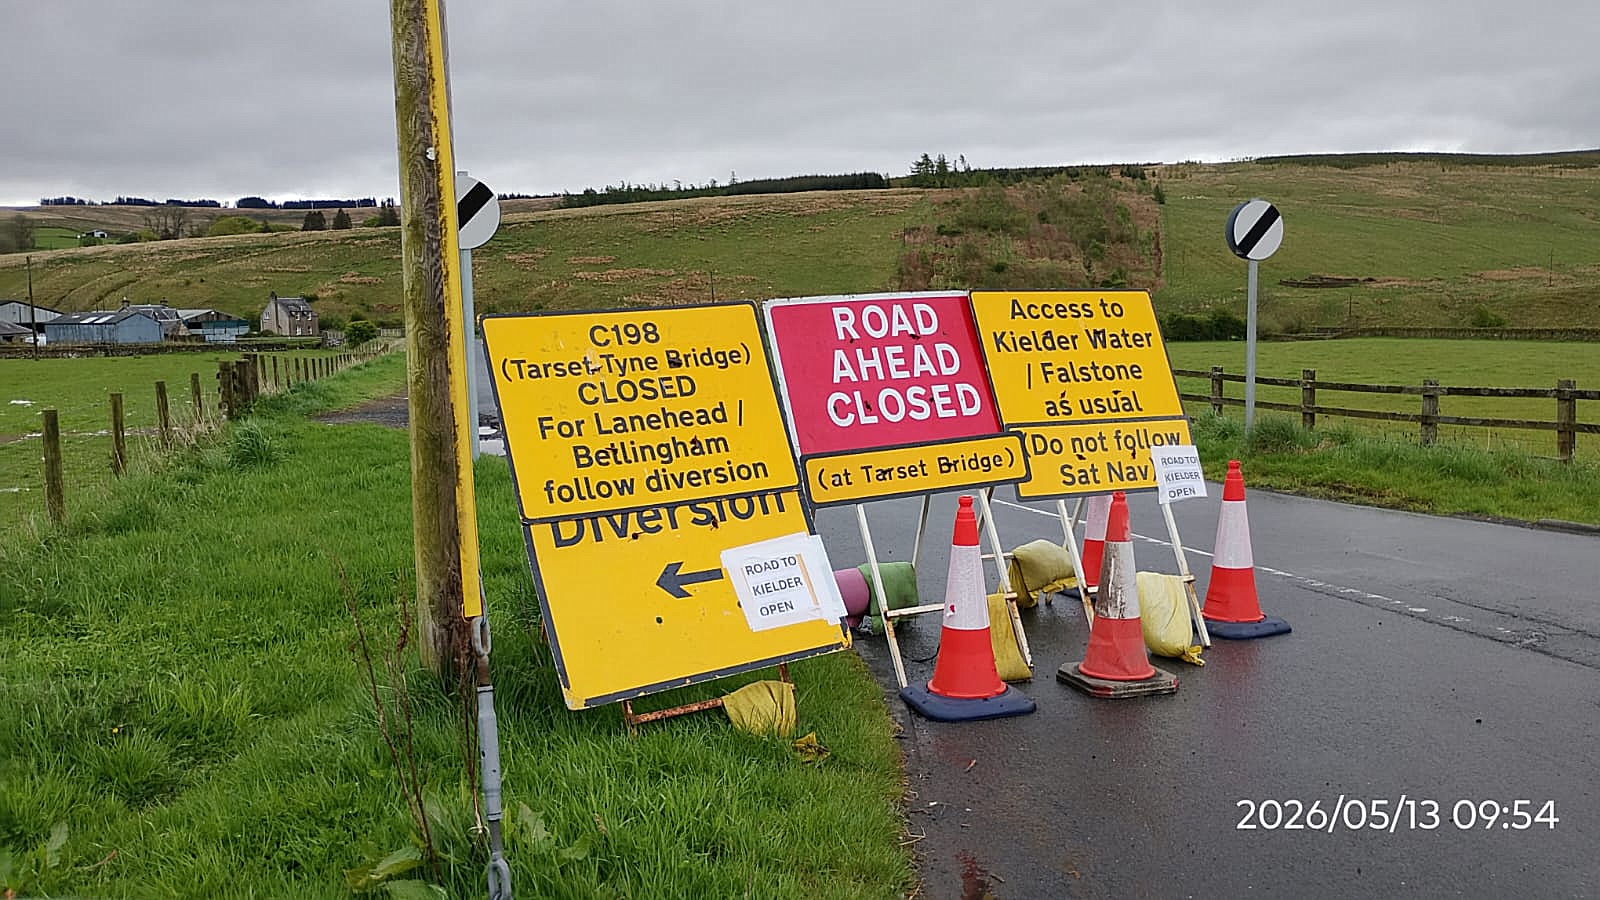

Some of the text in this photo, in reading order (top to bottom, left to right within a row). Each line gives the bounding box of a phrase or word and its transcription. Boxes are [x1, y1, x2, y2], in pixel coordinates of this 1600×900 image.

[832, 303, 939, 340] ROAD
[1010, 298, 1124, 320] Access to
[589, 322, 660, 348] C198
[993, 328, 1152, 352] Kielder Water
[501, 342, 751, 382] (Tarset Tyne Bridge)
[833, 343, 961, 384] AHEAD
[1026, 361, 1142, 390] / Falstone
[578, 375, 697, 406] CLOSED
[826, 383, 982, 427] CLOSED
[1045, 391, 1143, 417] as usual
[538, 400, 744, 441] For Lanehead /
[1071, 432, 1108, 456] not
[1114, 428, 1181, 452] follow
[818, 447, 1014, 490] (at Tarset Bridge)
[1161, 455, 1198, 466] ROAD TO
[543, 459, 769, 505] follow diversion
[1060, 462, 1101, 486] Sat
[1164, 471, 1200, 481] KIELDER
[1168, 487, 1196, 498] OPEN
[745, 556, 797, 576] ROAD TO
[752, 576, 803, 597] KIELDER
[759, 600, 794, 617] OPEN
